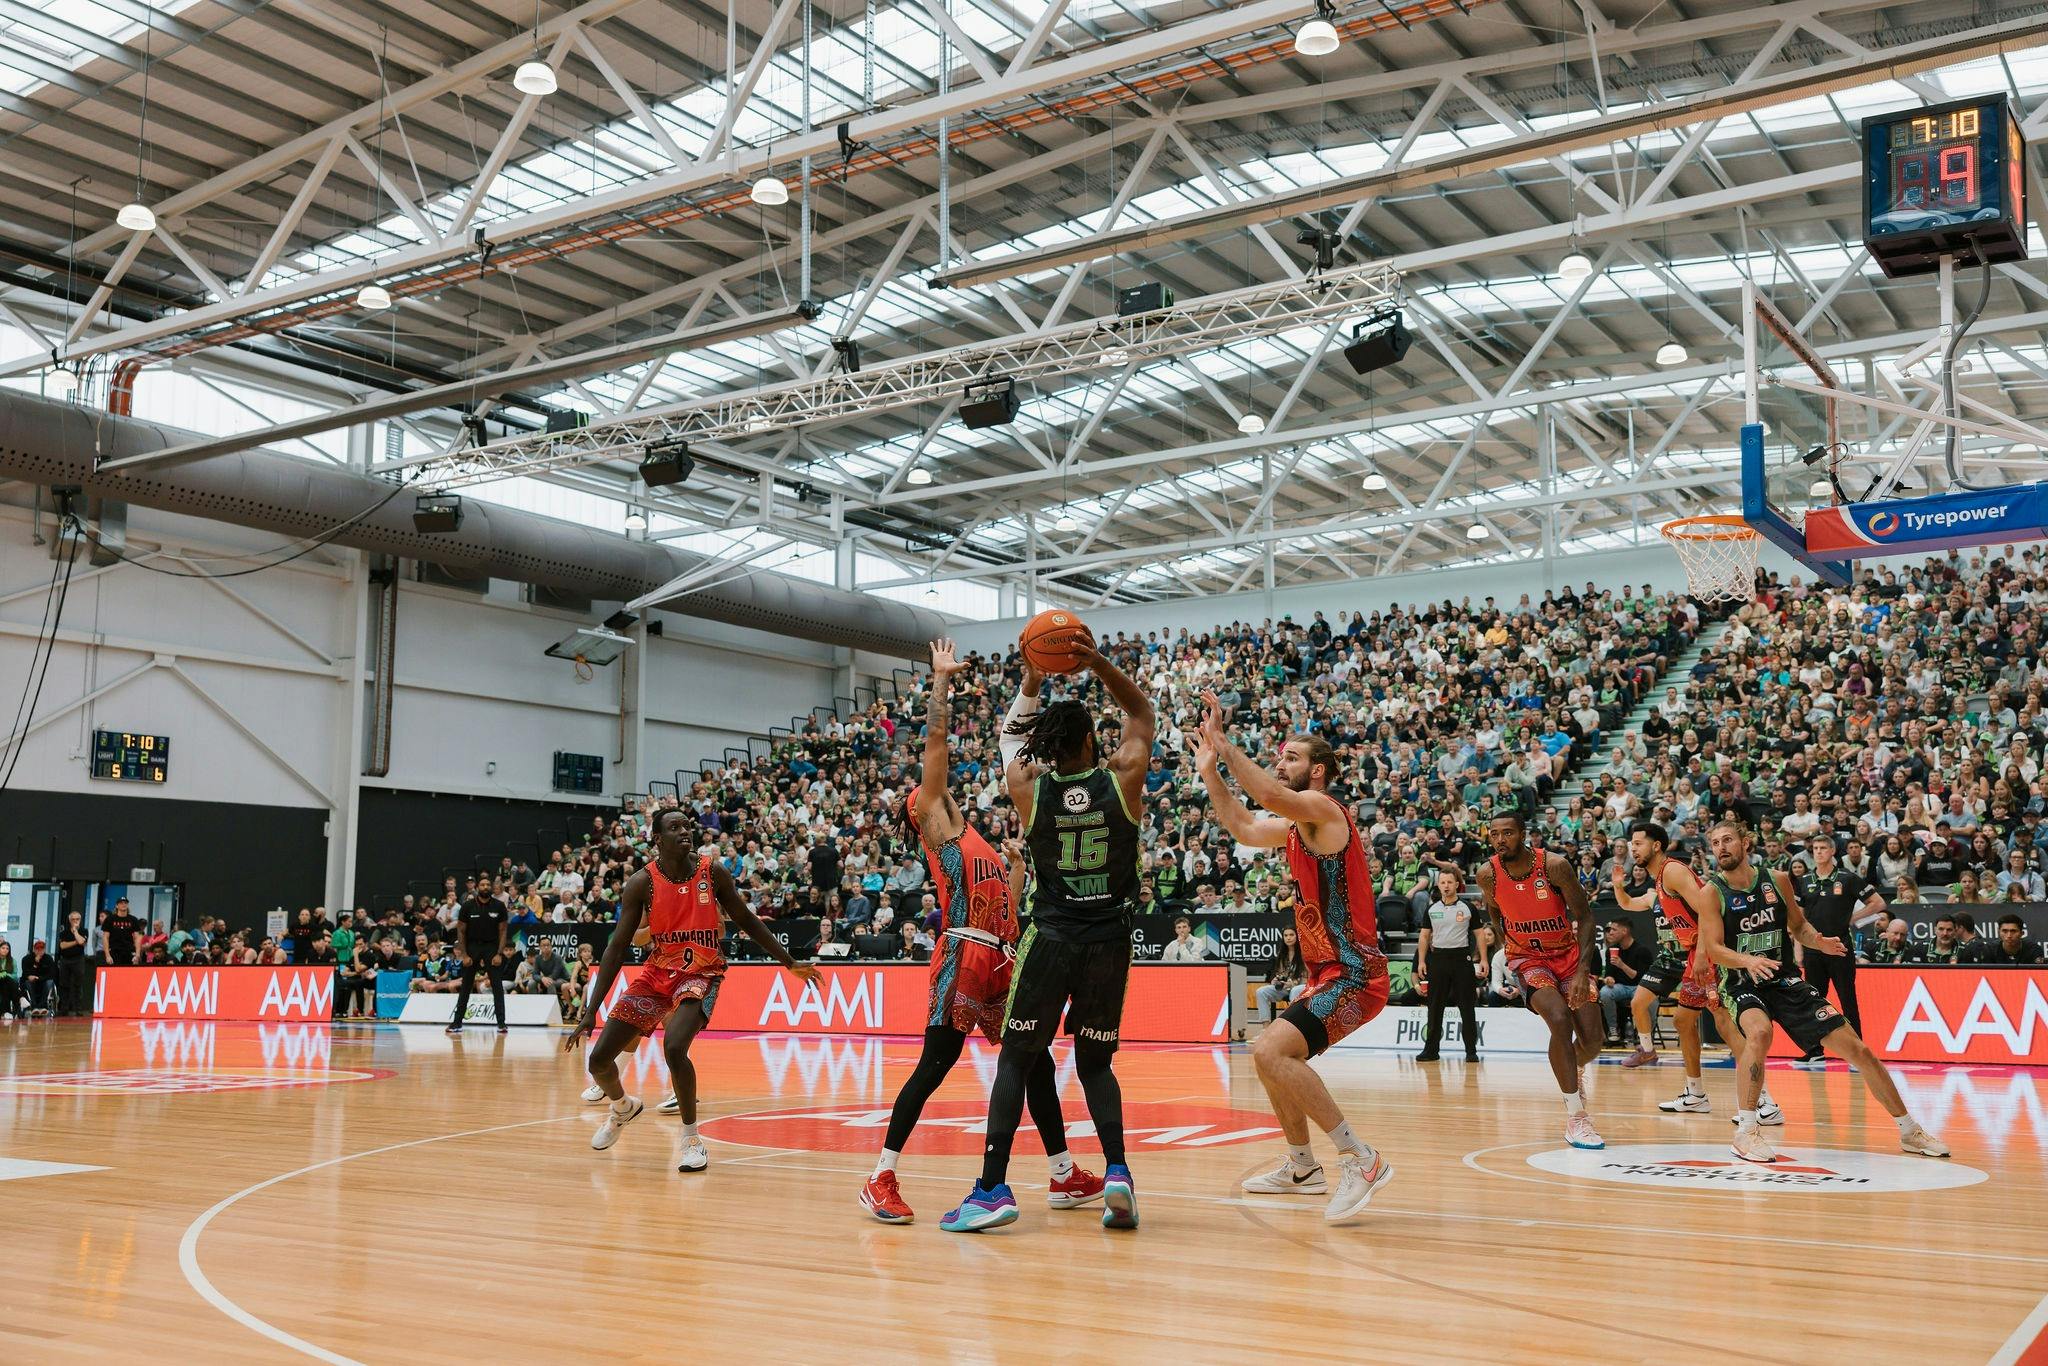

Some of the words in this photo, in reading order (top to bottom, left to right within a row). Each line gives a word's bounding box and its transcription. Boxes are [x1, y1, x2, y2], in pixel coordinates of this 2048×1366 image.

[1911, 109, 1979, 142] 7:10
[1940, 145, 1975, 203] 9
[1903, 505, 2008, 531] Tyrepower
[123, 734, 154, 750] 7:10
[140, 751, 149, 764] 2
[112, 763, 121, 778] 5
[154, 767, 163, 781] 6
[1067, 793, 1086, 806] a2
[1057, 827, 1109, 871] 15
[1504, 915, 1567, 934] AWARRA
[1740, 906, 1776, 932] GOAT
[1220, 928, 1283, 942] CLEANIN
[1912, 922, 2029, 939] CLNIG
[680, 946, 695, 972] 9
[1220, 944, 1280, 958] MELBOU
[139, 970, 220, 1015] AAMI
[758, 970, 884, 1028] AAMI
[449, 1003, 498, 1020] OENIX
[1008, 1018, 1038, 1031] GOAT
[1396, 1019, 1486, 1047] PHEX
